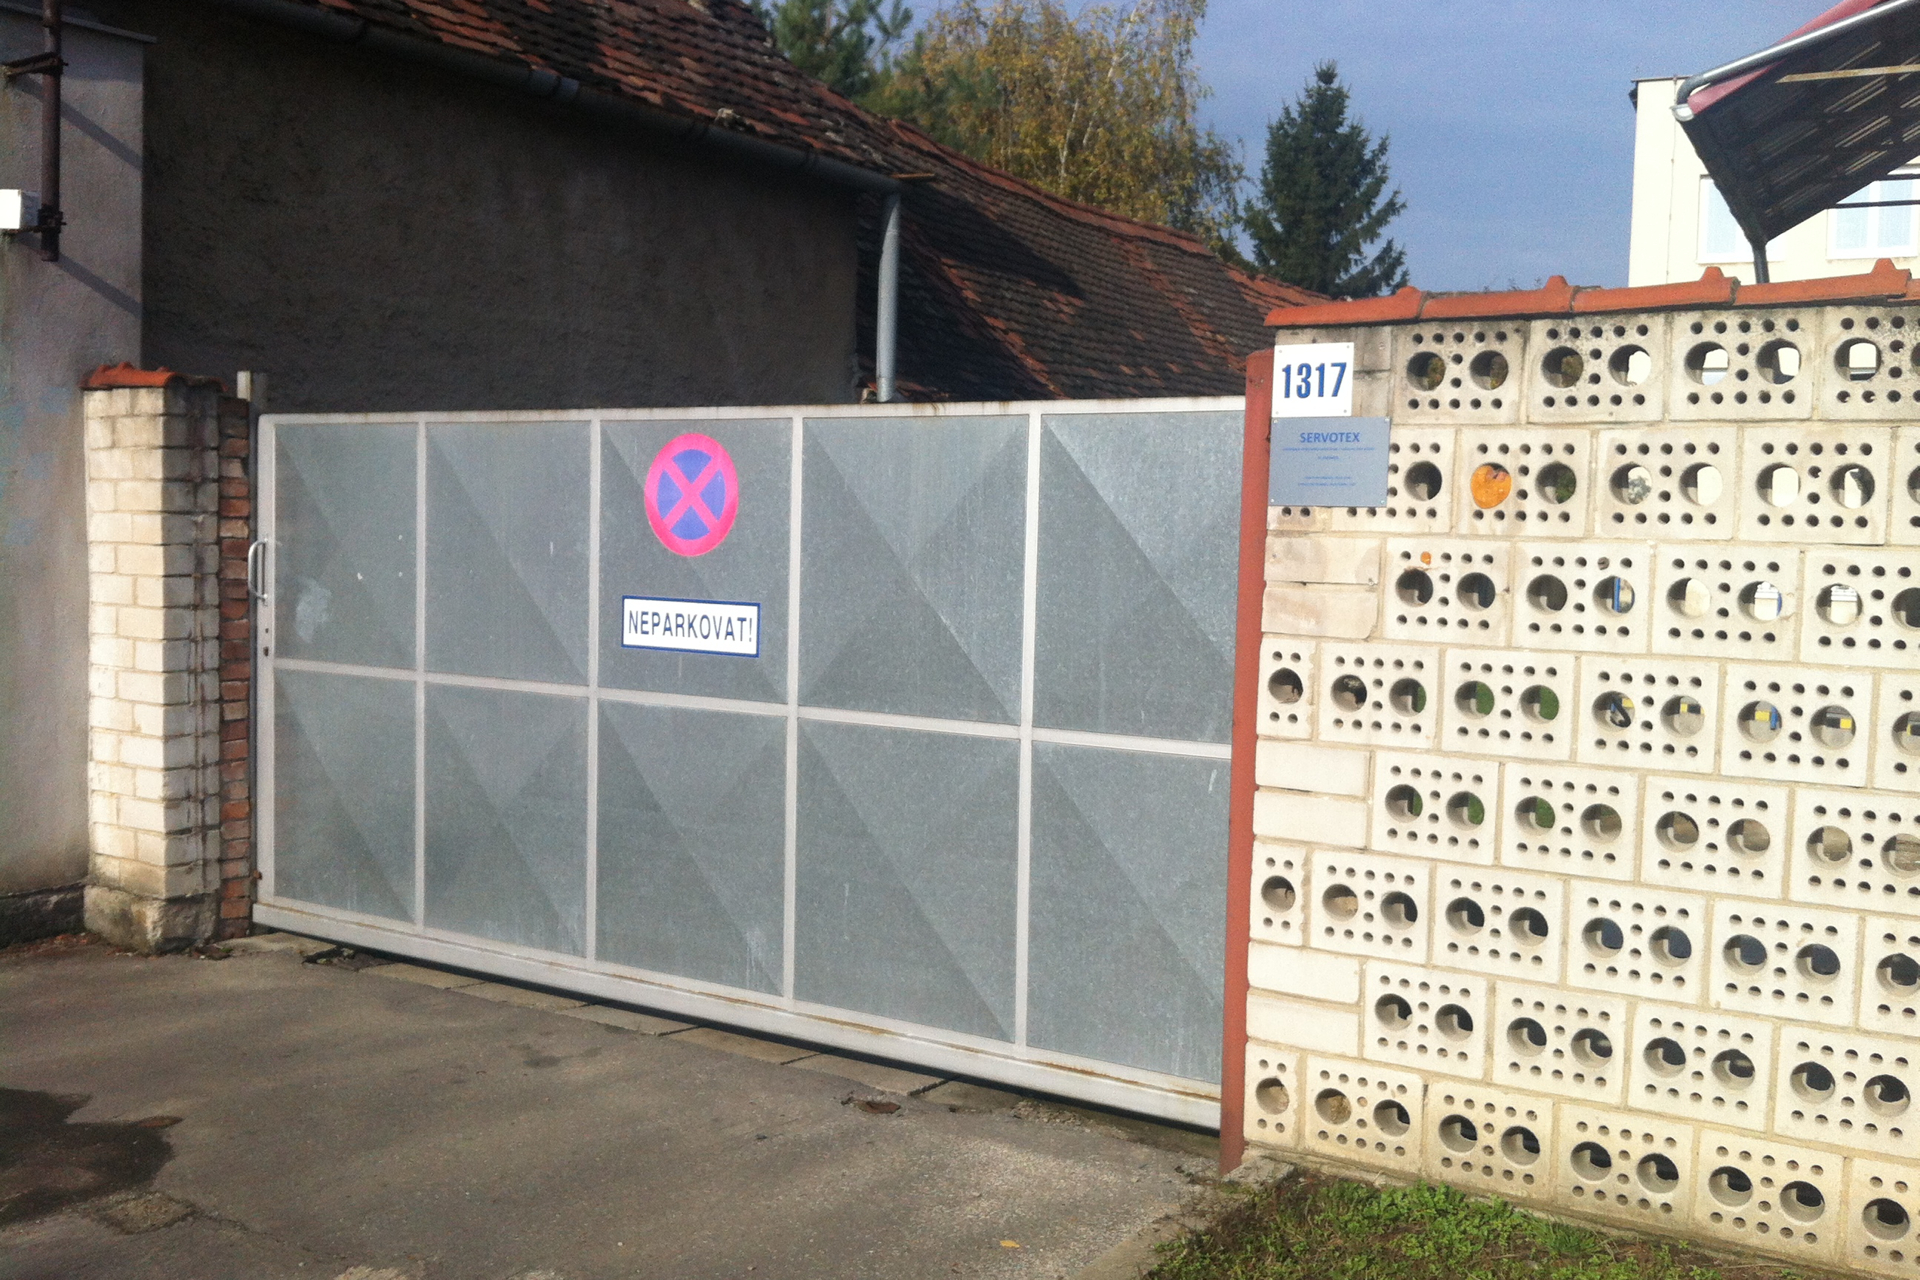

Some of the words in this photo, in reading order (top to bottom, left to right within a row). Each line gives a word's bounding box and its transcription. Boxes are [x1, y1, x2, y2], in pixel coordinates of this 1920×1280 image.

[1282, 362, 1347, 398] 1317
[1300, 432, 1360, 443] SERVOTEX
[629, 610, 752, 642] NEPARKOVAT!
